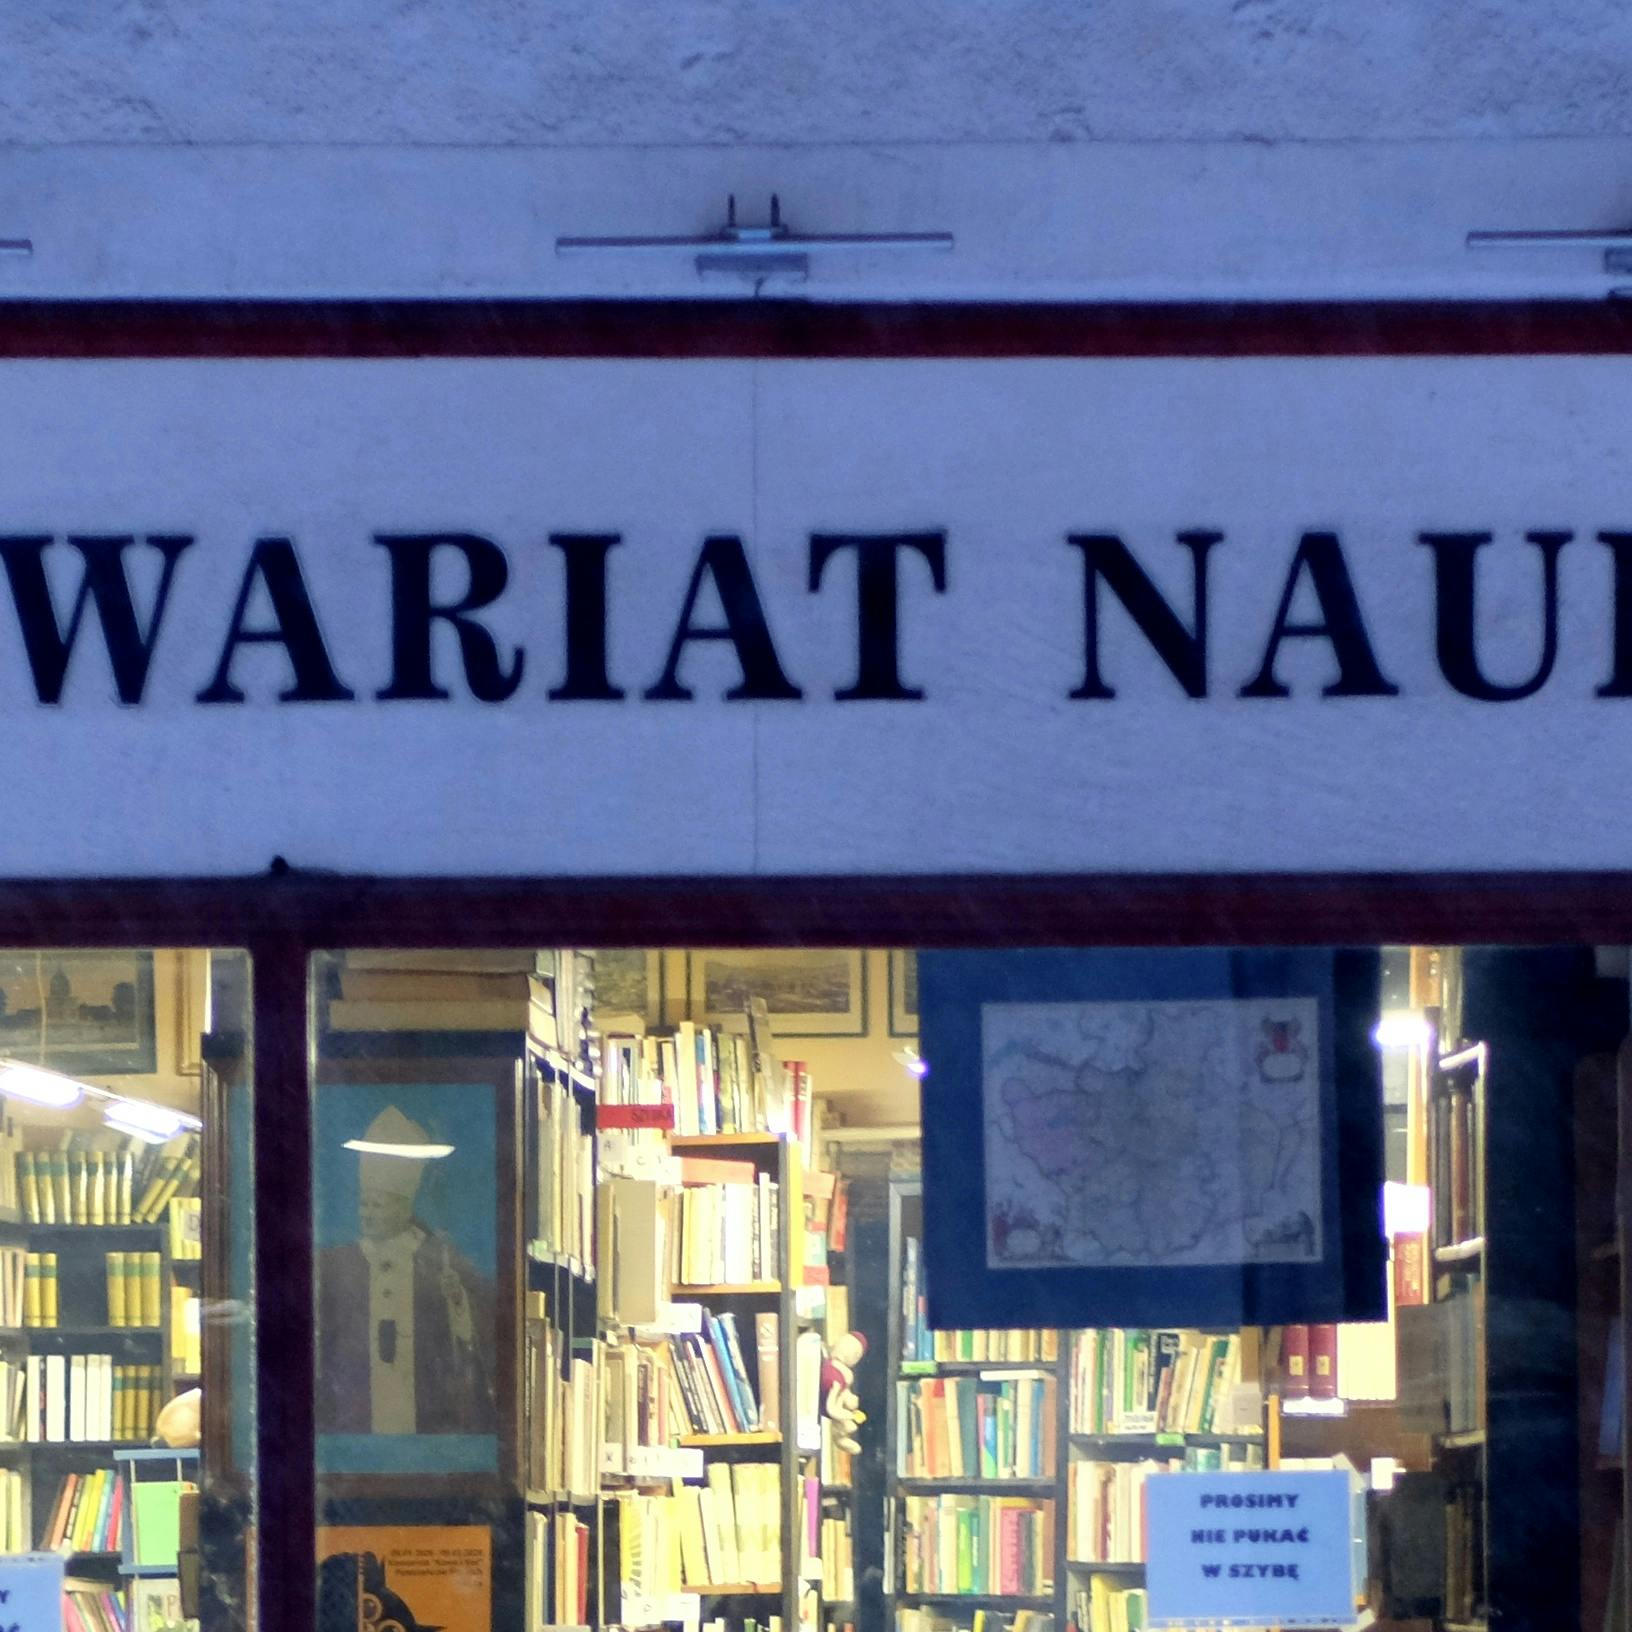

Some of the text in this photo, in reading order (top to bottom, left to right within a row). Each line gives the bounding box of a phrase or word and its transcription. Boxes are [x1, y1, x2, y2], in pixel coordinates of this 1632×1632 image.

[1200, 1493, 1300, 1509] PROSIMY
[1190, 1526, 1310, 1544] NIE PUKAĆ
[1201, 1564, 1300, 1581] W SZYBĘ
